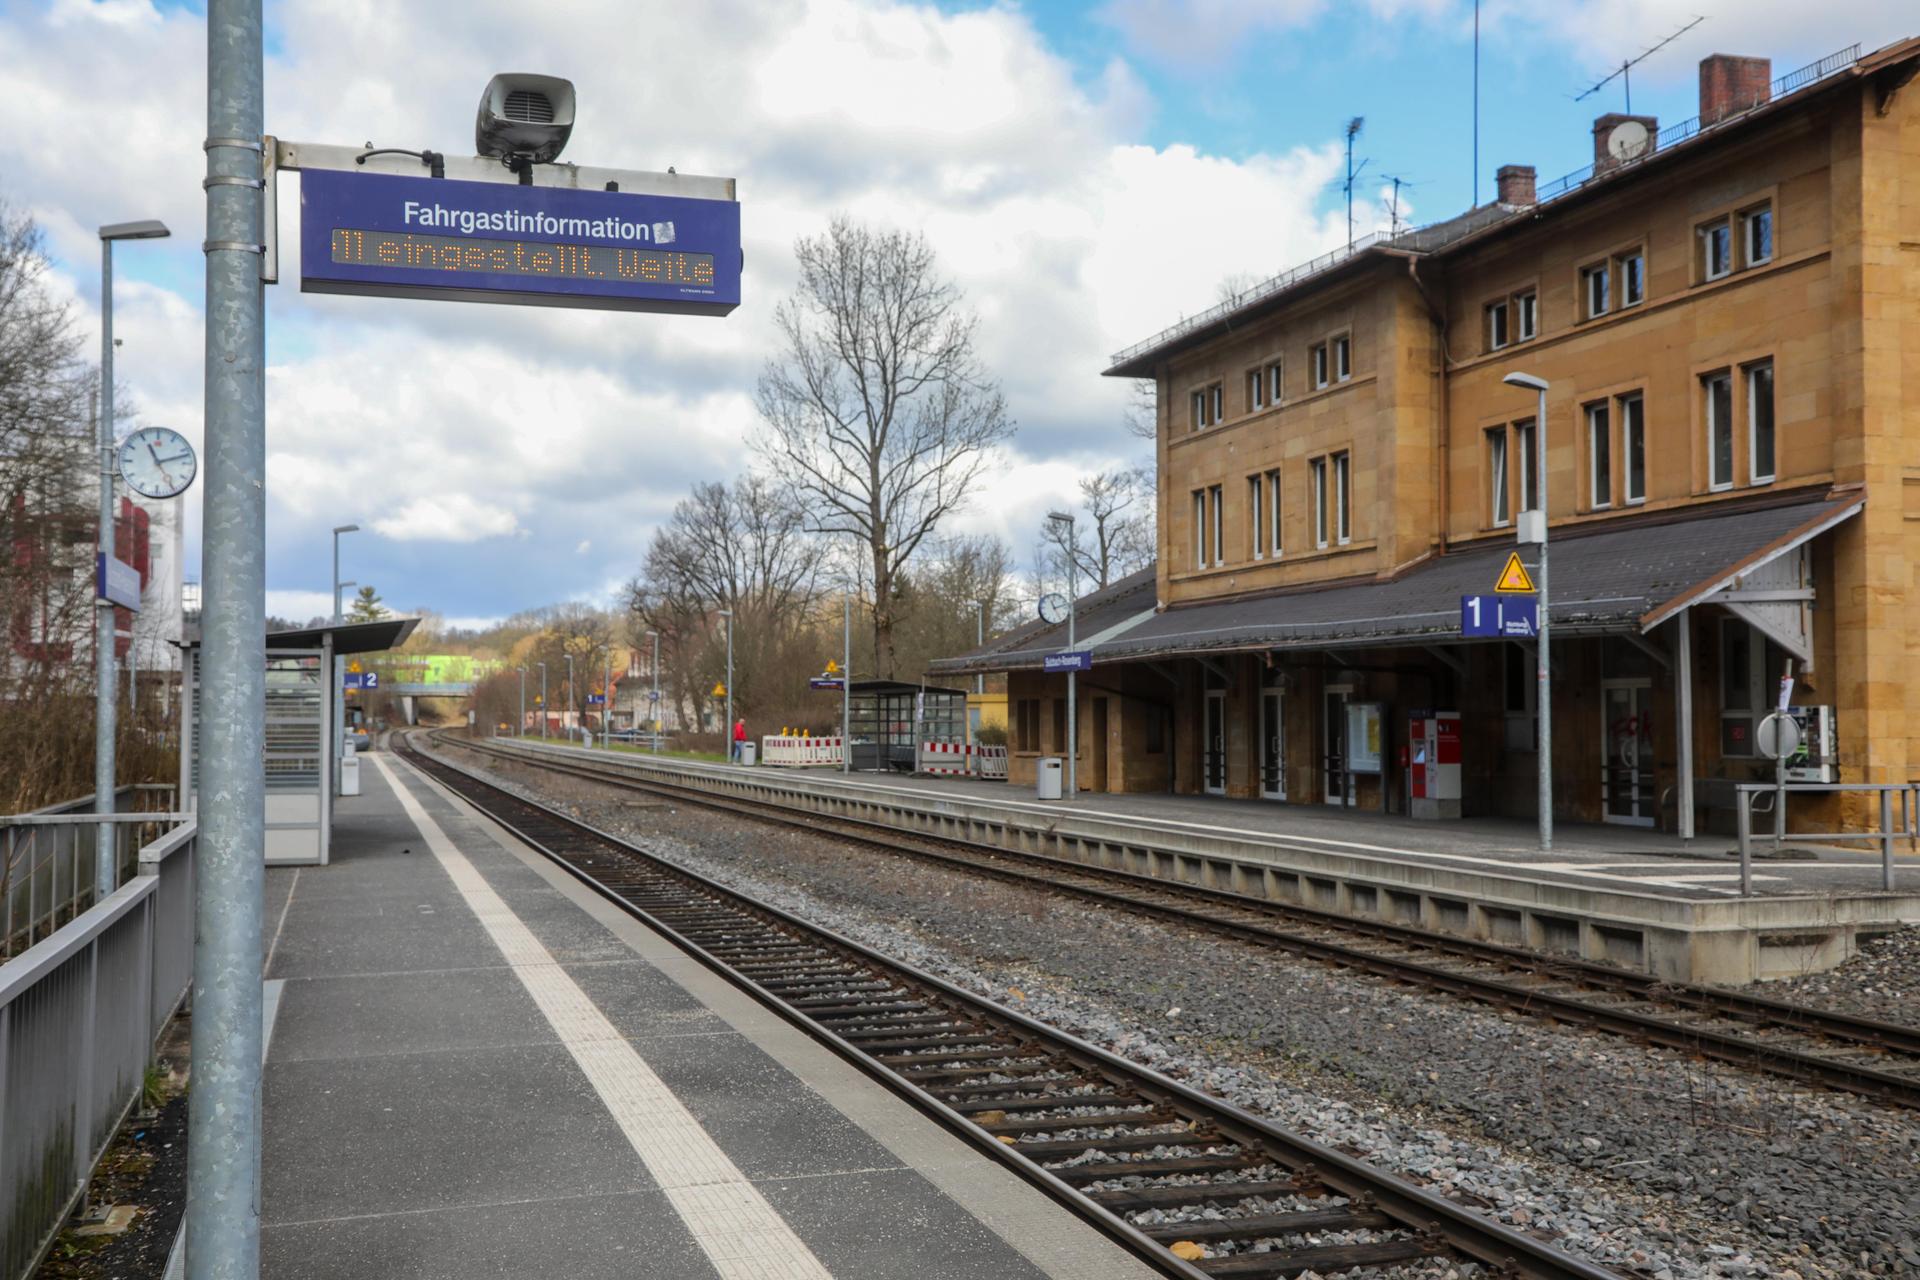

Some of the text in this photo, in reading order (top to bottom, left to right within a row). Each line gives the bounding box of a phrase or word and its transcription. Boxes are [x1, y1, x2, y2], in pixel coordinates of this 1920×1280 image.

[404, 201, 649, 241] Fahrgastinformation
[378, 235, 605, 276] eingestellt.
[617, 249, 713, 282] Weite
[1468, 596, 1480, 627] 1
[366, 672, 377, 687] 2
